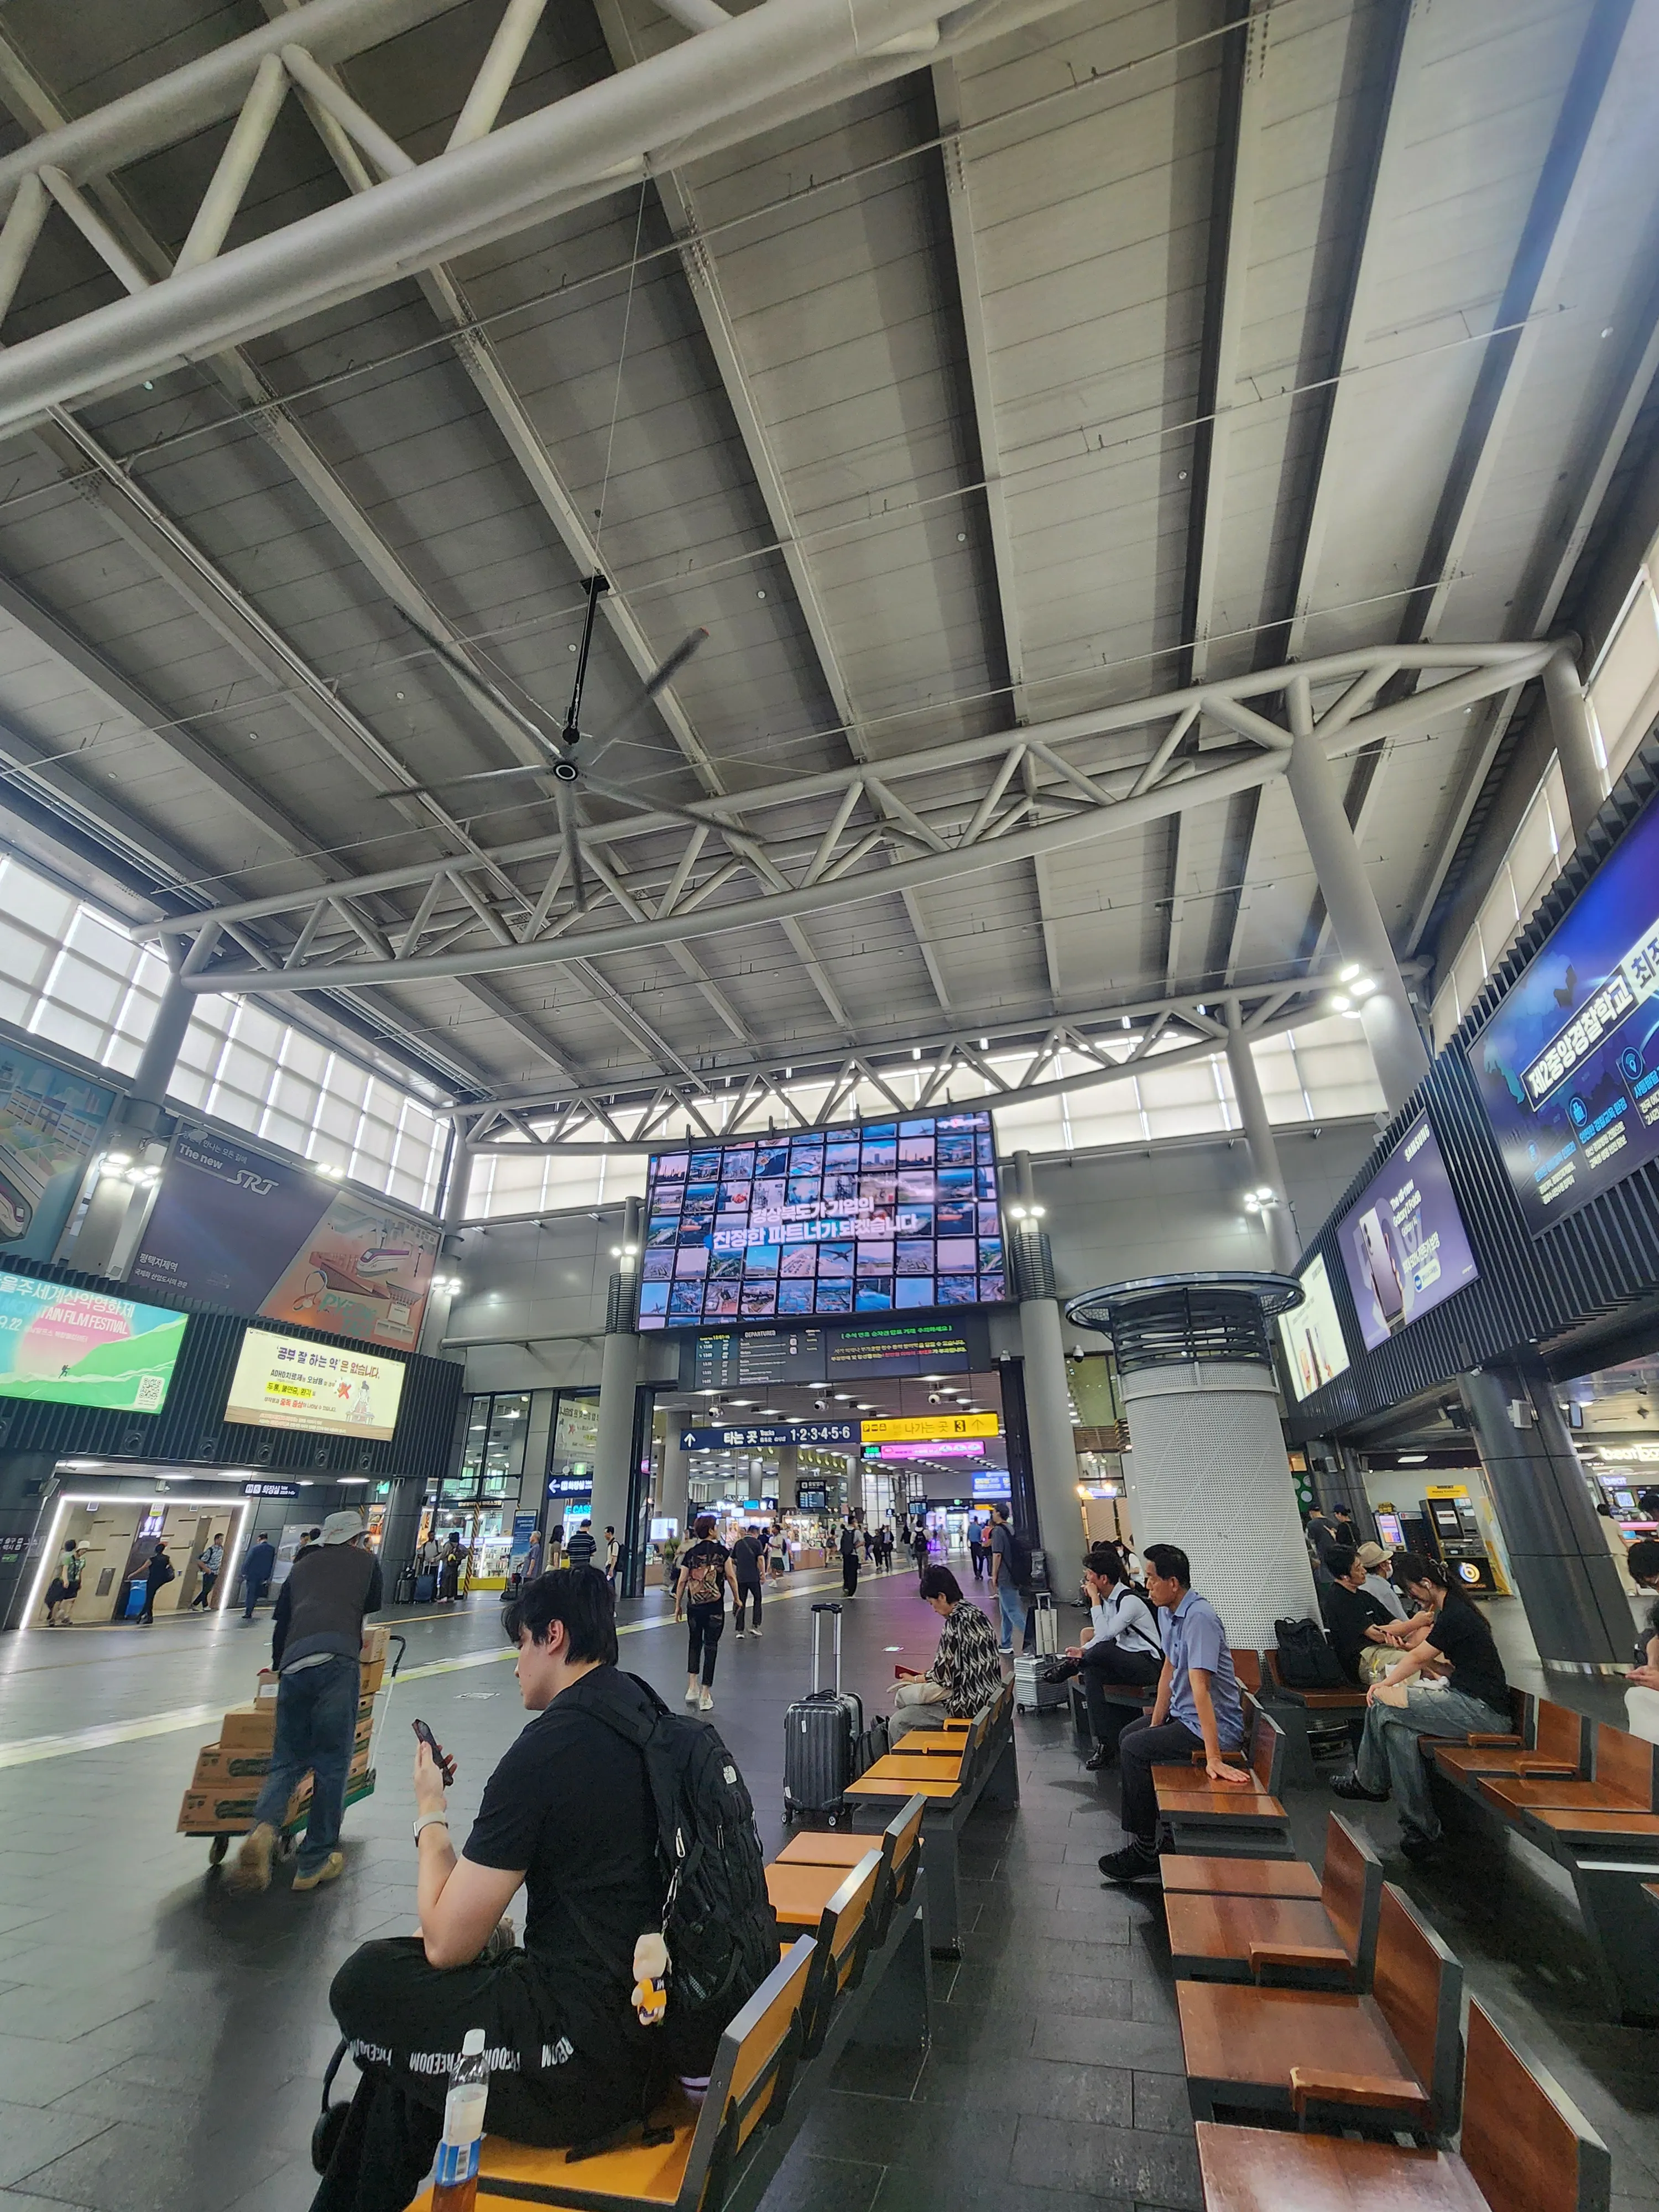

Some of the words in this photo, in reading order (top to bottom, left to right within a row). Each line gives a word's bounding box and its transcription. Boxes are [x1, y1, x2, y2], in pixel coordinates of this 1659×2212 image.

[1528, 974, 1634, 1099] 제2중앙경찰학교
[203, 1139, 221, 1154] 만나는
[222, 1148, 234, 1159] 모든
[1405, 1124, 1430, 1162] SAMSUNG
[179, 1143, 199, 1160] The
[200, 1154, 223, 1170] new
[227, 1169, 279, 1195] SRT
[753, 1202, 827, 1224] 경상북도가
[826, 1196, 874, 1217] 기업의
[713, 1227, 766, 1249] 진정한
[768, 1220, 838, 1244] 파트너가
[839, 1213, 917, 1238] 되겠습니다
[139, 1253, 179, 1272] 평택지제역
[151, 1272, 178, 1286] 산업도시의
[0, 1275, 135, 1318] 울주세계산악영화제
[62, 1310, 89, 1327] FILM
[88, 1313, 128, 1334] FESTIVAL
[298, 1352, 307, 1364] 잘
[309, 1354, 327, 1369] 하는
[723, 1431, 744, 1445] 타는
[747, 1431, 758, 1444] 곳
[905, 1422, 935, 1434] 나가는
[938, 1421, 948, 1432] 곳
[957, 1421, 964, 1432] 3
[262, 1485, 280, 1494] 화장실
[409, 2051, 461, 2075] FREEDOM
